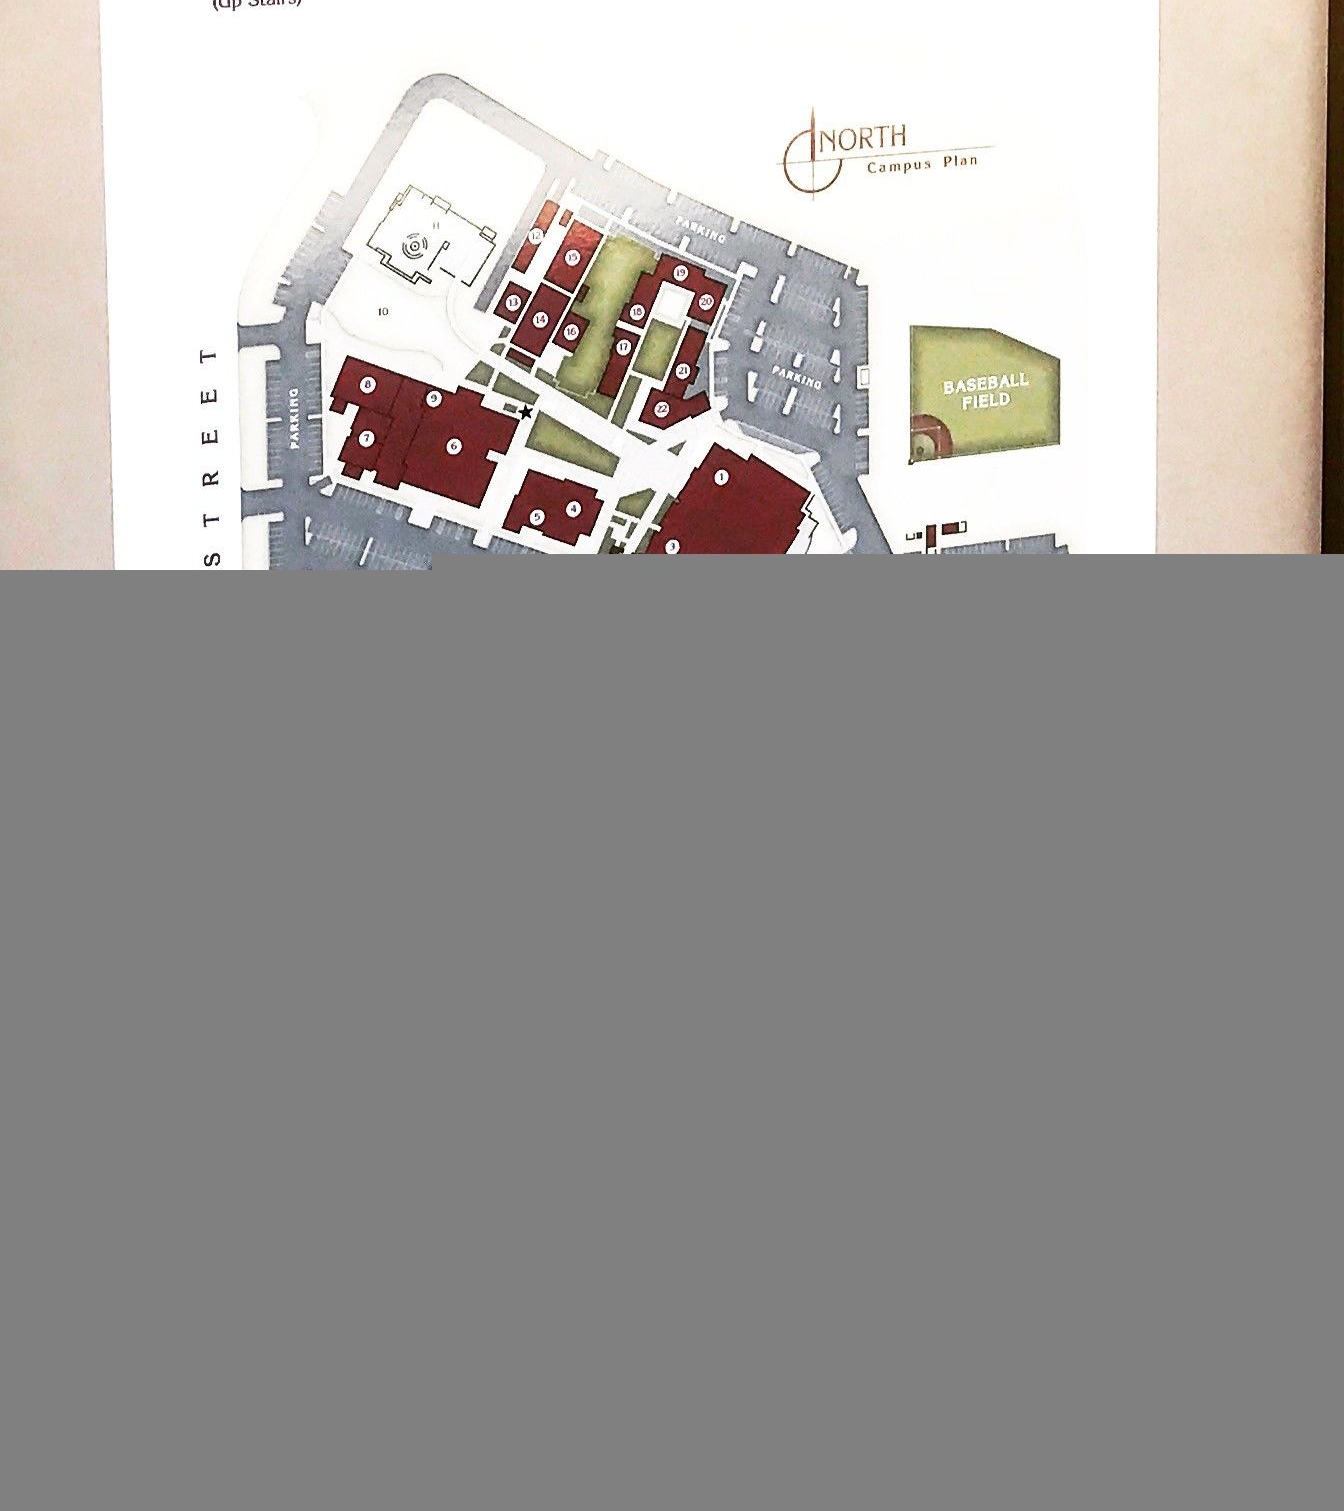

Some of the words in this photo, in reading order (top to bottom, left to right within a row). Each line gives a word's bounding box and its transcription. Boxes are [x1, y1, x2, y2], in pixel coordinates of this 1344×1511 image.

[819, 124, 907, 153] NORTH
[867, 161, 931, 174] Campus
[944, 155, 977, 167] Plan
[675, 215, 727, 244] PARKING
[508, 298, 518, 306] 13
[378, 308, 388, 316] 10
[633, 308, 642, 316] 18
[772, 365, 822, 390] PARKING
[944, 373, 1029, 394] BASEBALL
[430, 395, 437, 403] 9
[962, 393, 1010, 410] FIELD
[657, 405, 666, 413] 22
[290, 388, 299, 450] PARKING
[450, 442, 457, 450] 6
[200, 350, 221, 566] STREET
[720, 472, 724, 481] 1
[570, 505, 577, 513] 4
[535, 513, 540, 521] 5
[670, 542, 675, 550] 3
